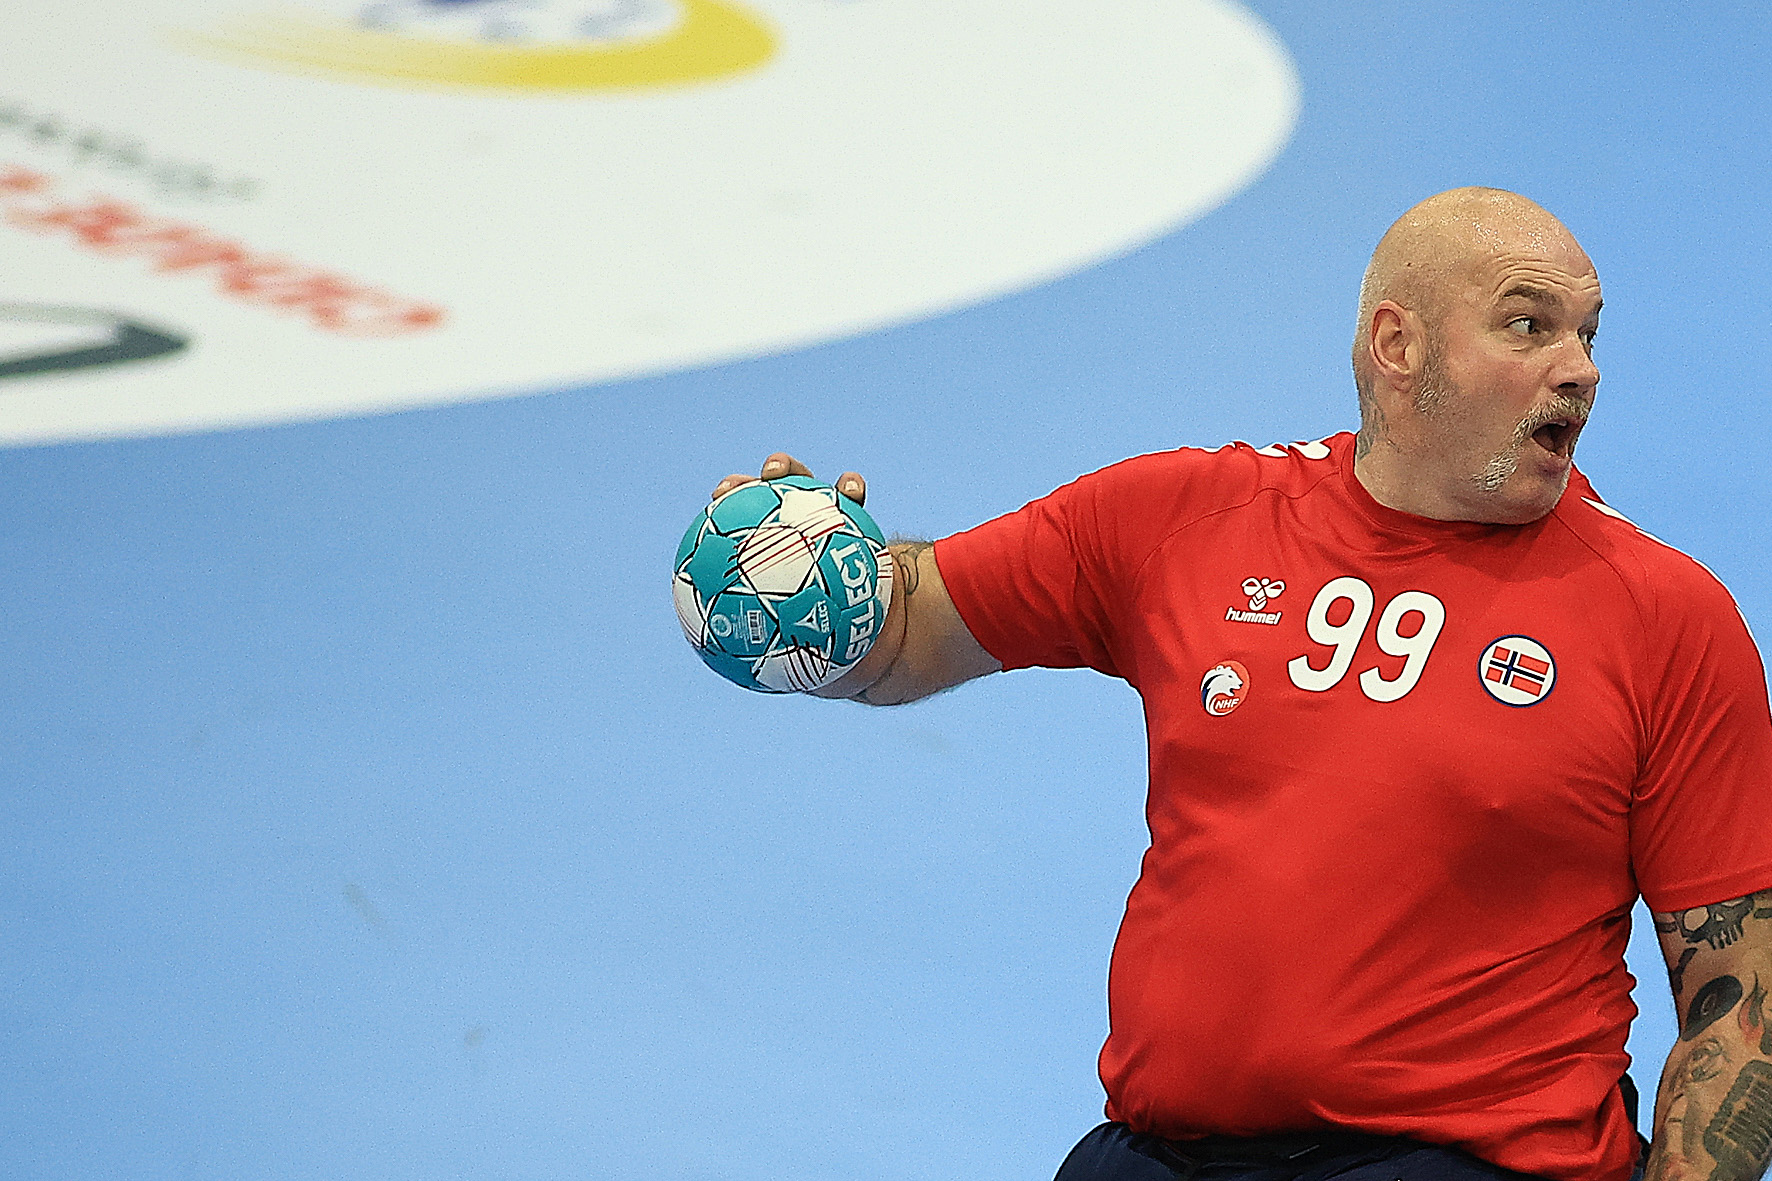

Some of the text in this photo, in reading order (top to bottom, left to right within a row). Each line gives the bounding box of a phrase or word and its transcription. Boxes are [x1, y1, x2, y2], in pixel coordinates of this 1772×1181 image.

[817, 600, 830, 634] SELECT
[830, 541, 875, 660] SELECT
[1225, 606, 1282, 625] hummel
[1288, 576, 1446, 702] 99
[1215, 697, 1240, 710] NHF
